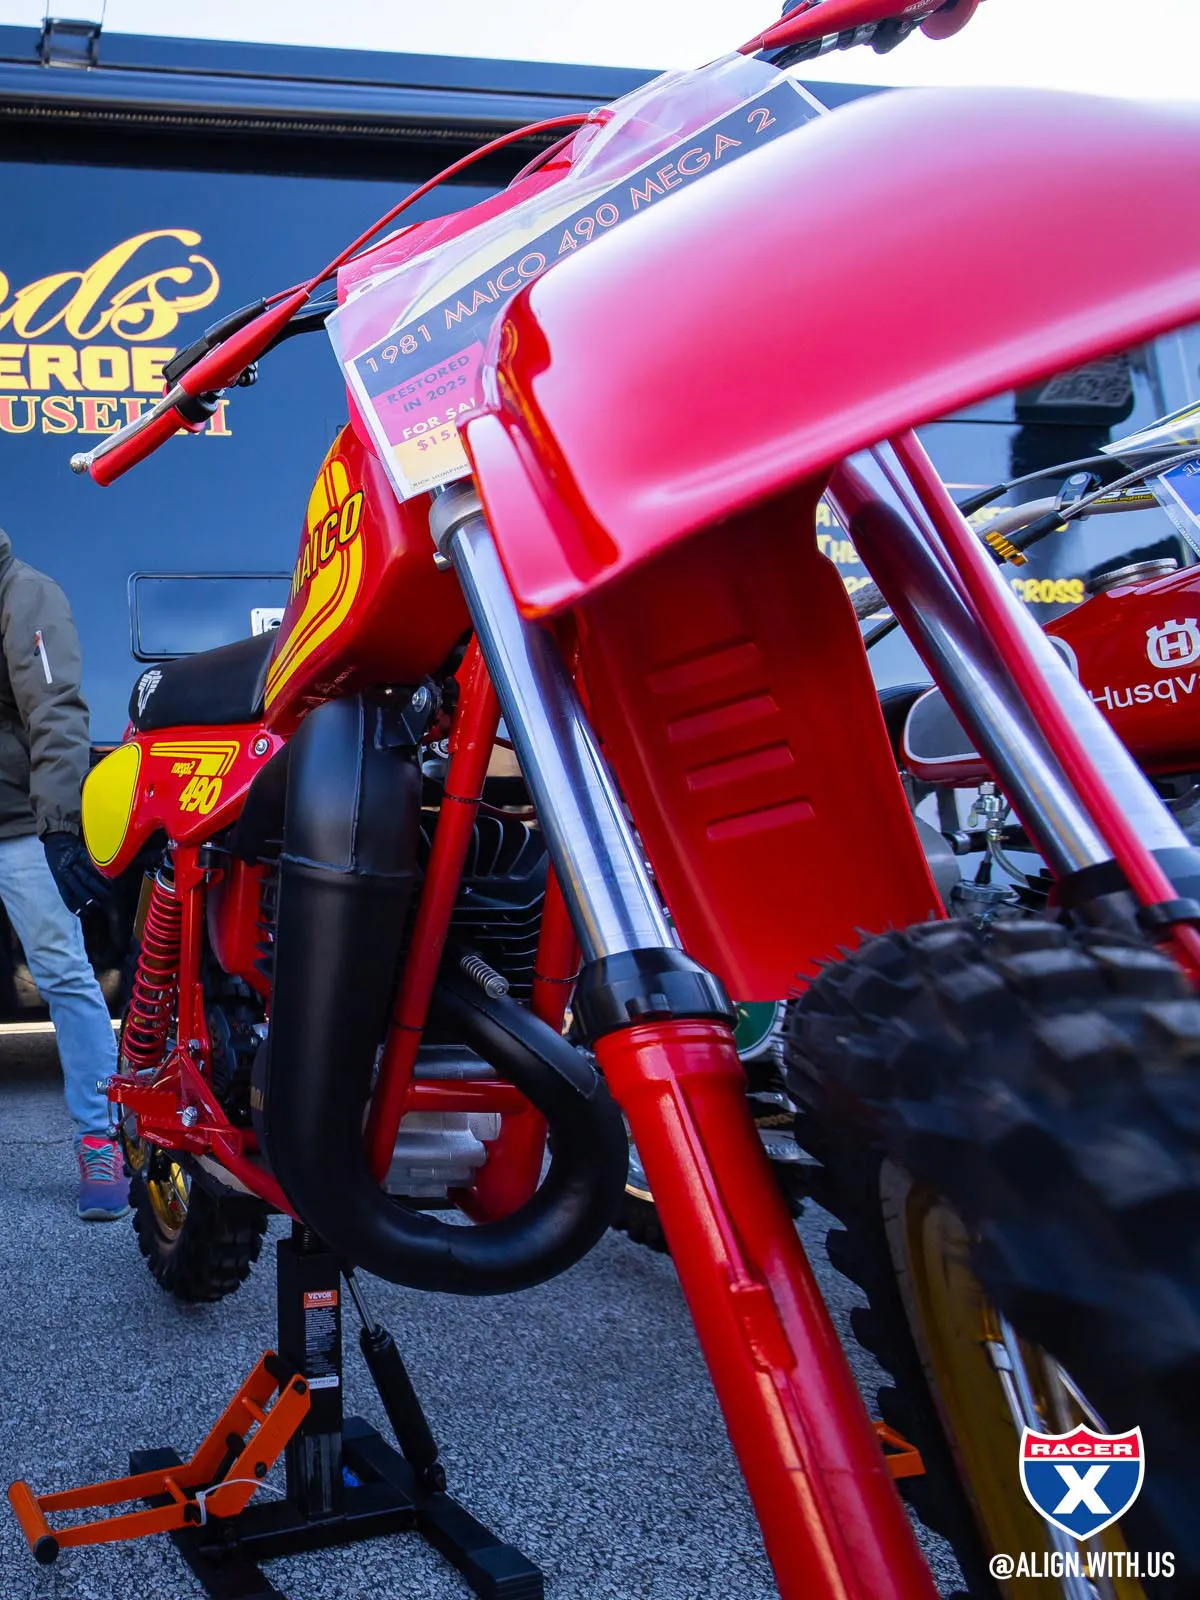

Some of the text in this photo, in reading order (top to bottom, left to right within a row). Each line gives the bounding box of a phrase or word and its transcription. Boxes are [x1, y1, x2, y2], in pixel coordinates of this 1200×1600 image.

[365, 107, 776, 373] 1981 MAICO 490 MEGA 2
[387, 355, 470, 404] RESTORED
[402, 375, 467, 413] IN 2025
[402, 397, 477, 439] FOR SA
[416, 429, 458, 452] $15,
[290, 489, 364, 606] MAICO
[1088, 673, 1200, 710] Husqv
[179, 776, 223, 815] 490
[308, 1291, 332, 1300] VEVOR
